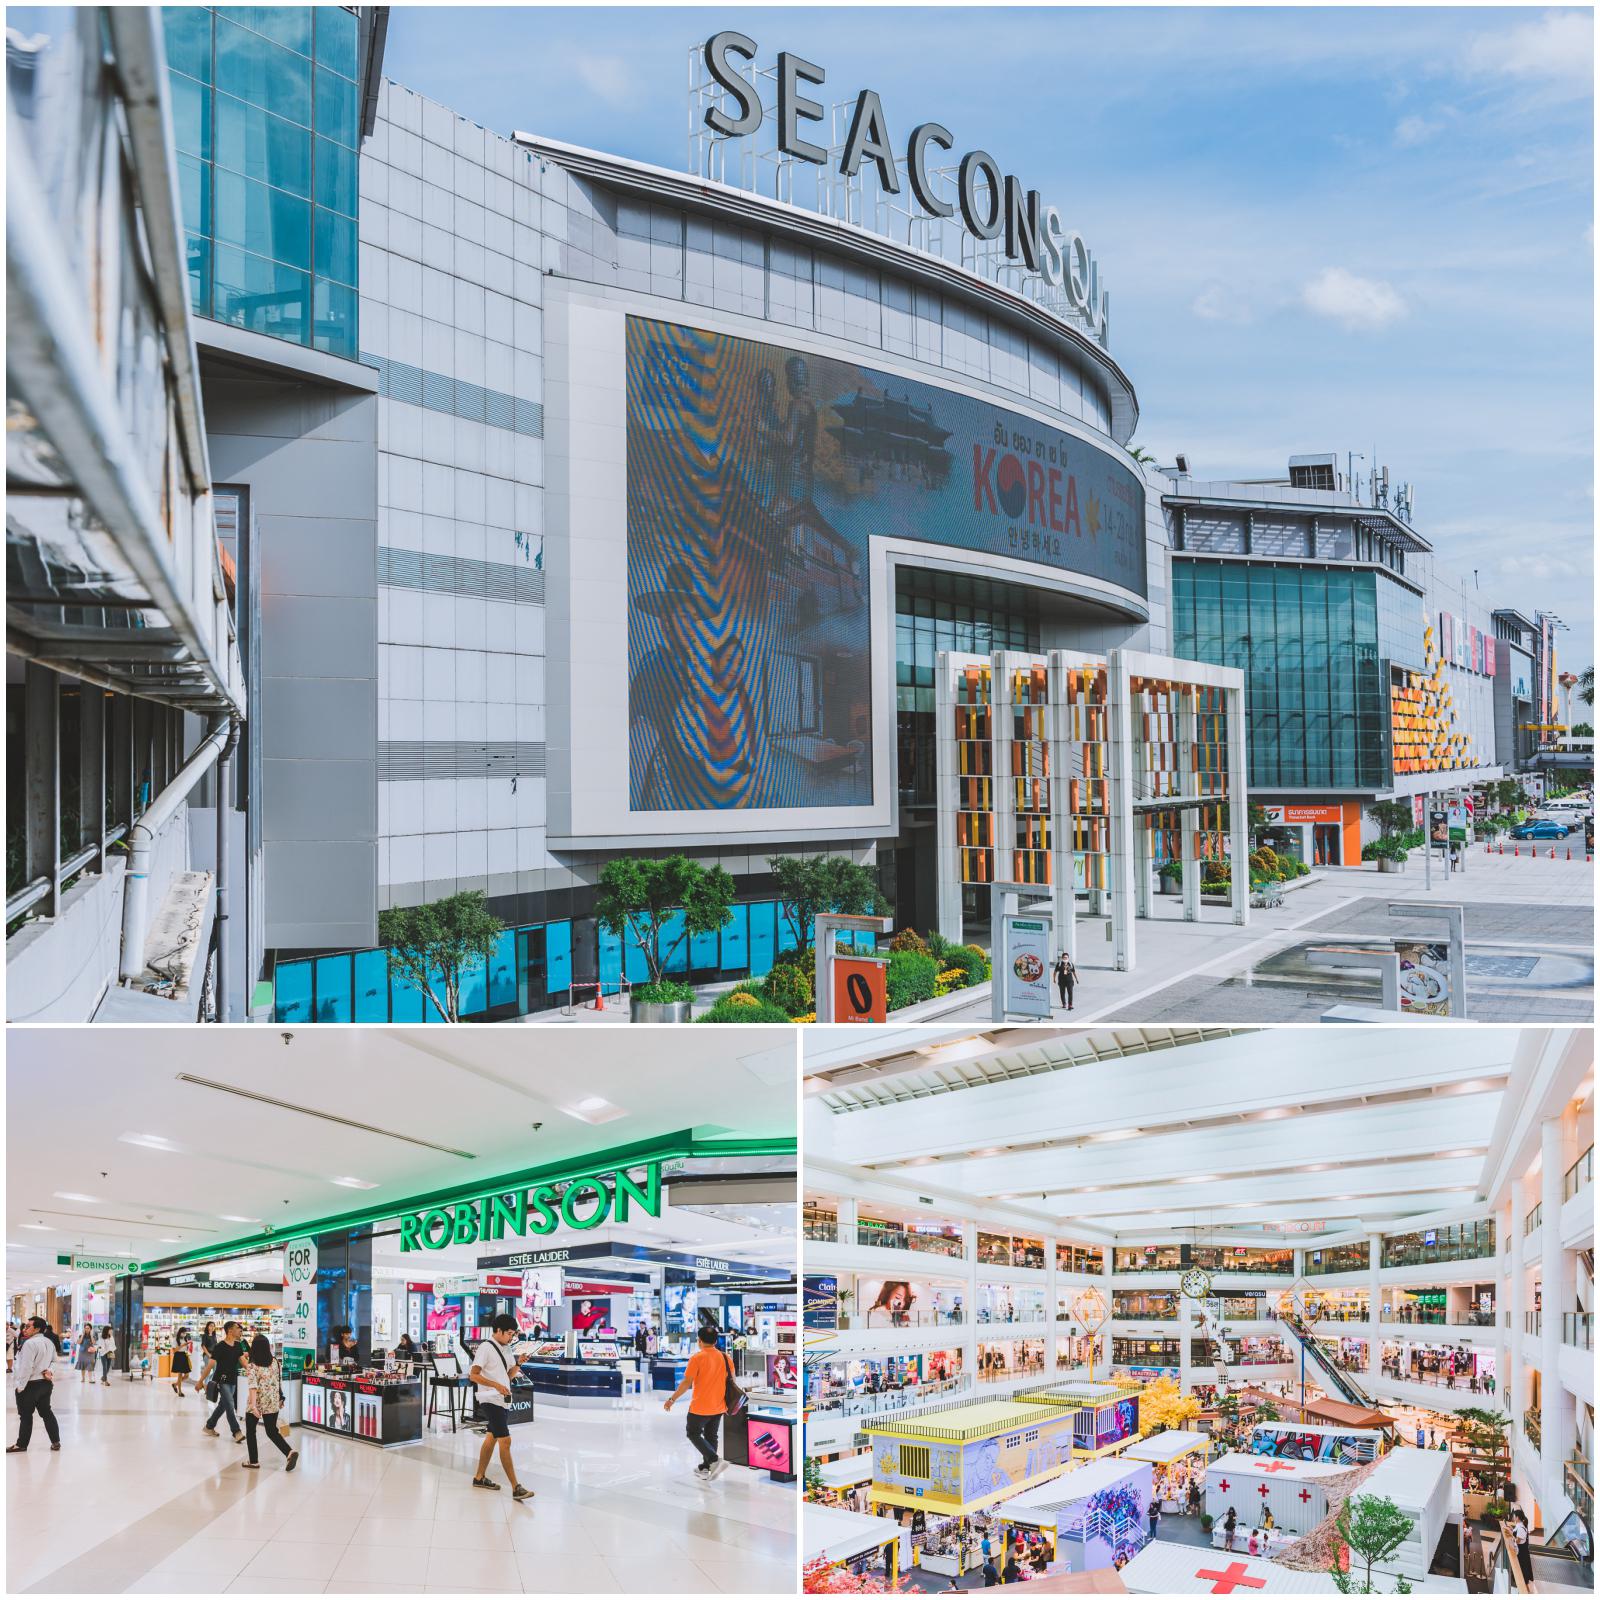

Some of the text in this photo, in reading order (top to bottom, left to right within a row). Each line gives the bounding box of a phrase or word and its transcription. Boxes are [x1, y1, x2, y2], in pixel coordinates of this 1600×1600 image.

[704, 30, 1040, 273] SEACON
[973, 443, 1081, 537] KOREA
[400, 1162, 662, 1253] ROBINSON
[290, 1248, 310, 1267] FOR
[533, 1250, 569, 1263] LAUDER
[76, 1261, 124, 1270] ROBINSON
[213, 1281, 235, 1289] BODY
[296, 1302, 310, 1319] 40
[298, 1327, 306, 1340] 15
[509, 1401, 532, 1412] EVLON
